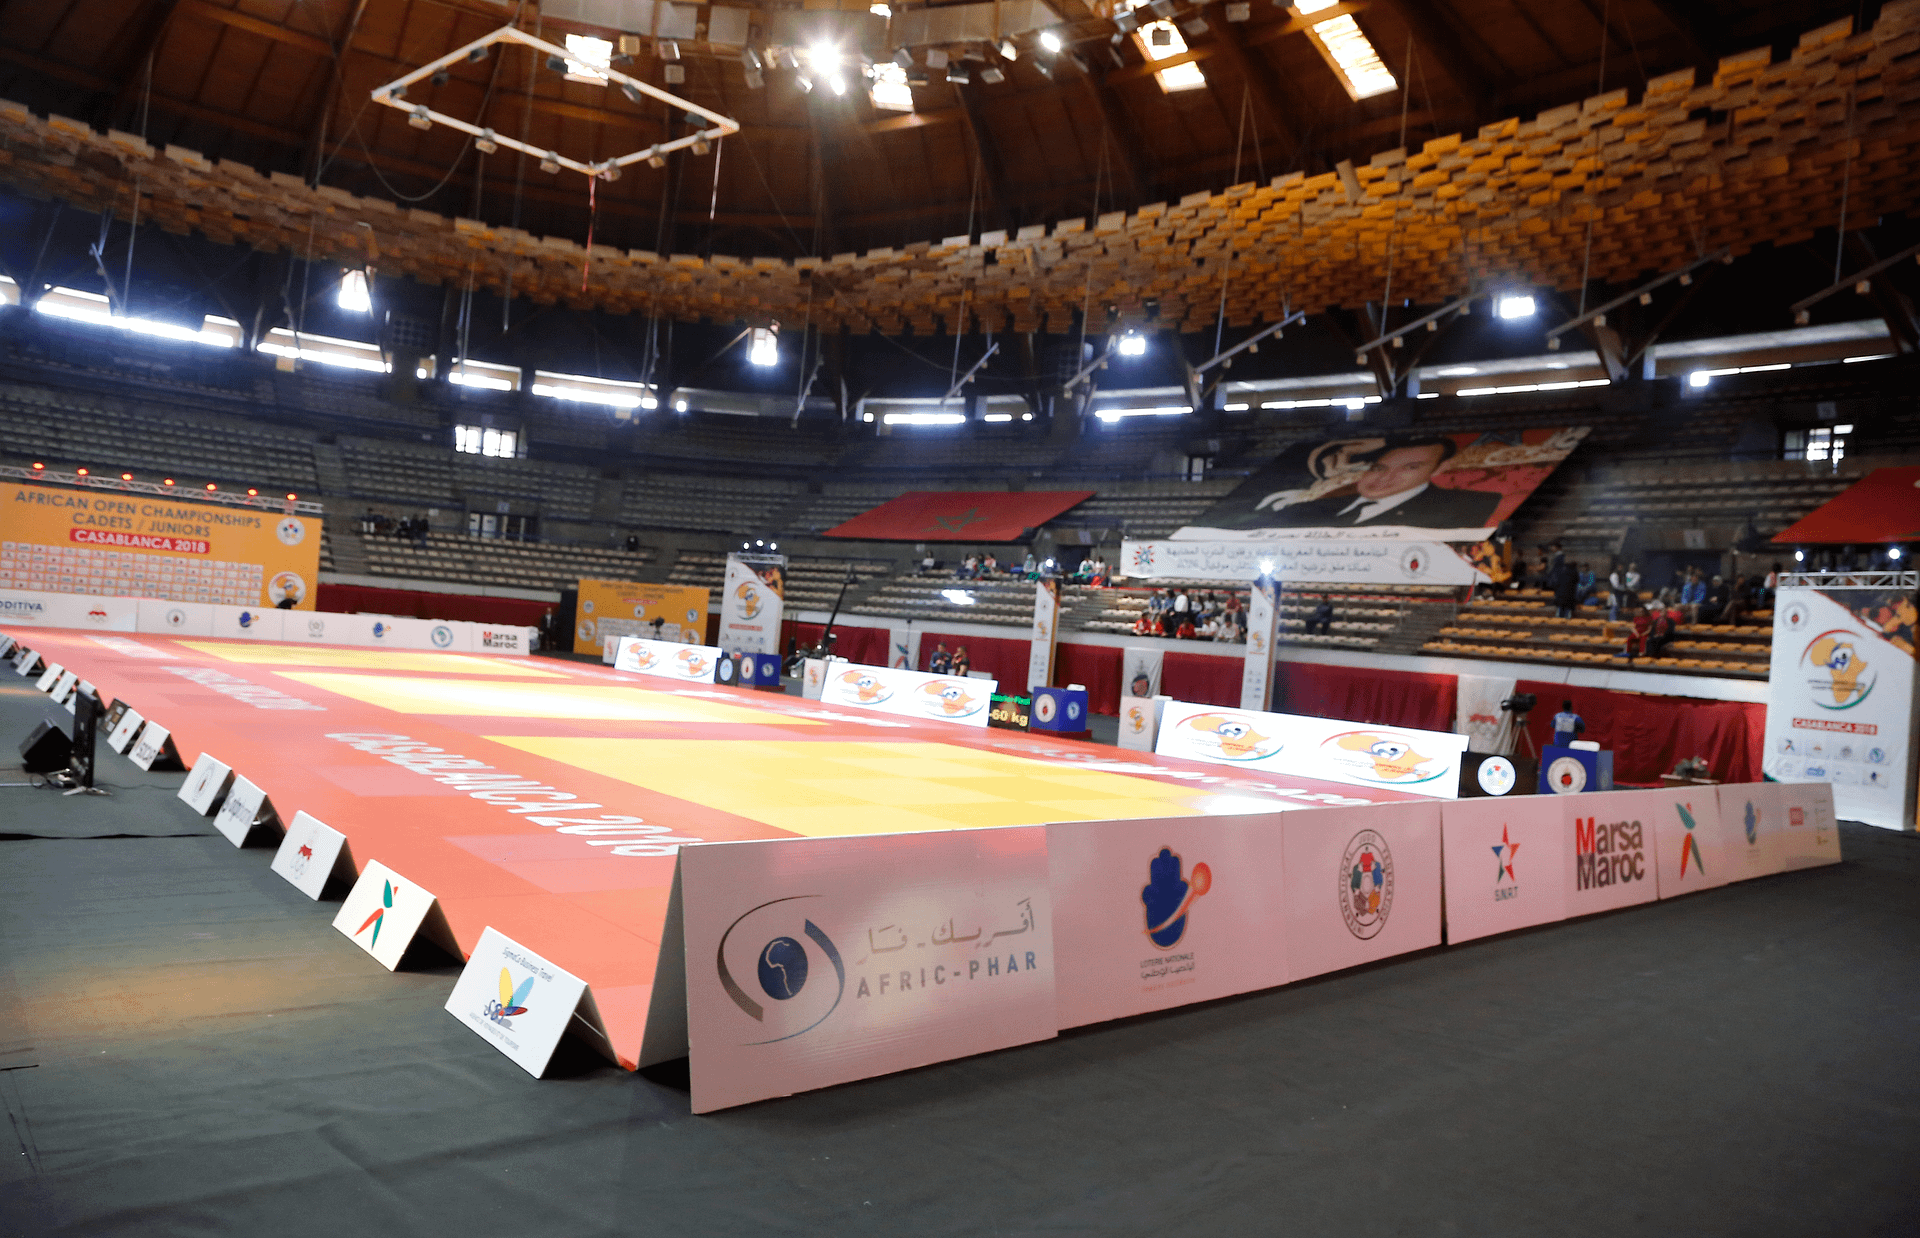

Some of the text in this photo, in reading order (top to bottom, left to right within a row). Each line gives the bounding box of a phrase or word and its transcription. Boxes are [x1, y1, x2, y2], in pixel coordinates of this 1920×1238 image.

[15, 490, 262, 529] AFRICAN OPEN CHAMPIONSHIPS
[72, 512, 132, 530] CADETS
[149, 521, 211, 537] JUNIORS
[75, 529, 206, 553] CASABLANCA 2018
[483, 631, 518, 641] Marsa
[483, 639, 518, 649] Maroc
[1010, 711, 1029, 727] kg
[324, 732, 603, 814] CASABLANCA
[1575, 817, 1643, 856] Marsa
[1576, 851, 1645, 892] Maroc
[856, 950, 1037, 999] AFRIC-PHAR
